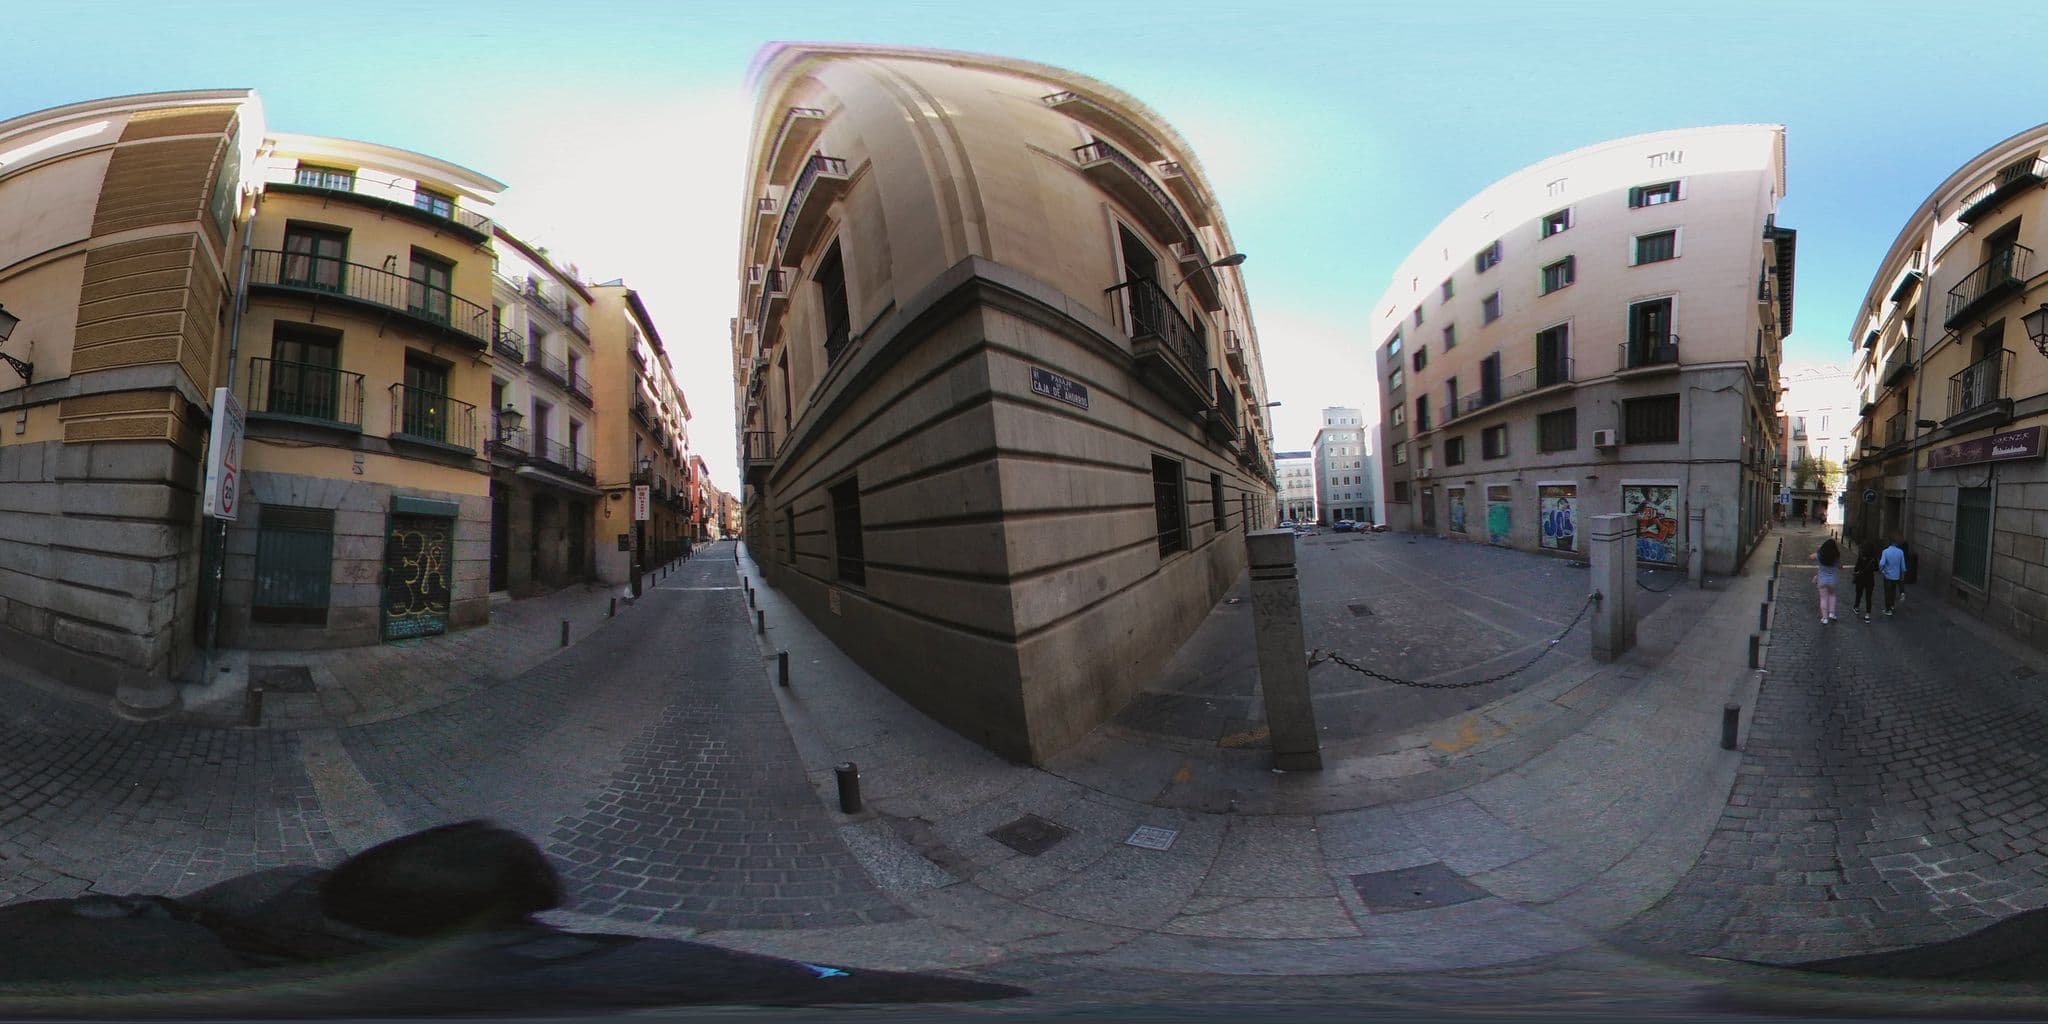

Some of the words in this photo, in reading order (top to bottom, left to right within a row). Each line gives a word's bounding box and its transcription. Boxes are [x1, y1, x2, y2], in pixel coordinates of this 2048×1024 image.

[1033, 380, 1050, 394] CAJA
[1053, 386, 1062, 397] DE
[1051, 375, 1072, 388] PASAJE
